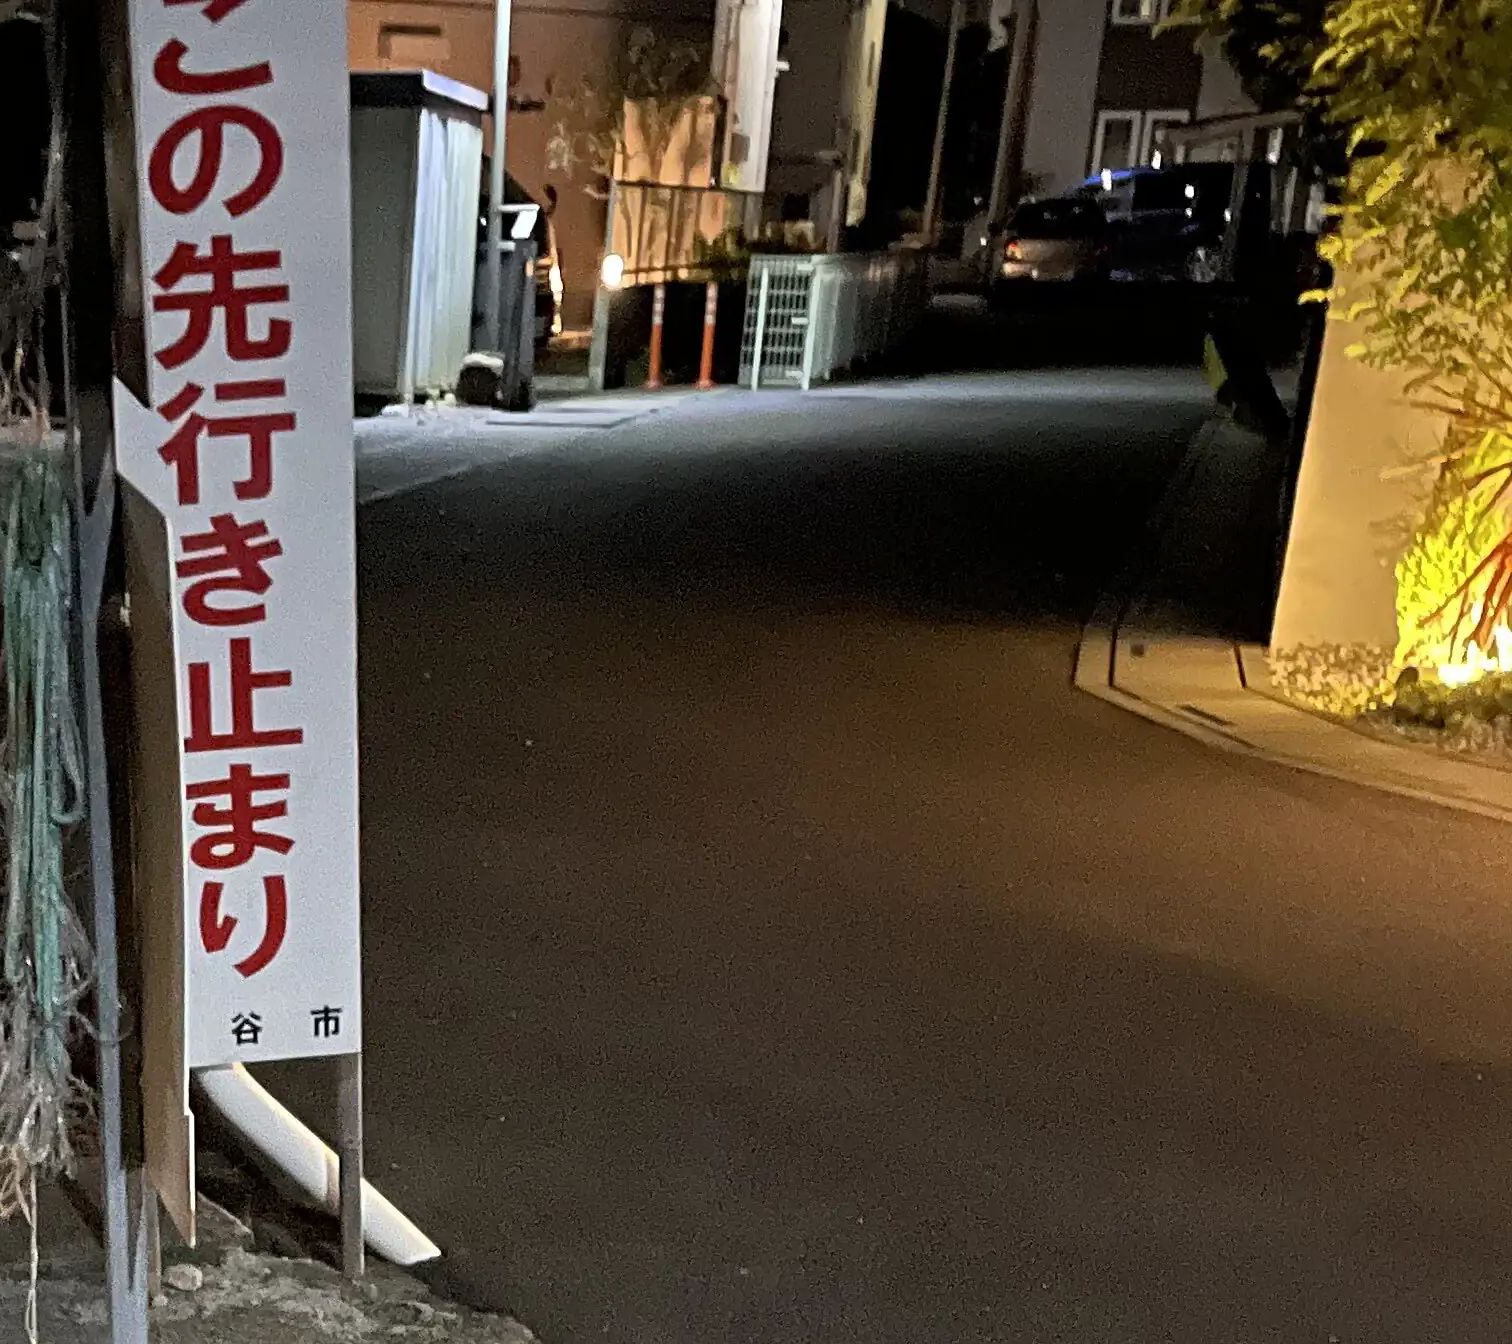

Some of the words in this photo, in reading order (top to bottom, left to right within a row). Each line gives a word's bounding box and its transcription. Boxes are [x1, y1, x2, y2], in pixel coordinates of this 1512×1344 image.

[148, 0, 304, 978] この先行き止まり
